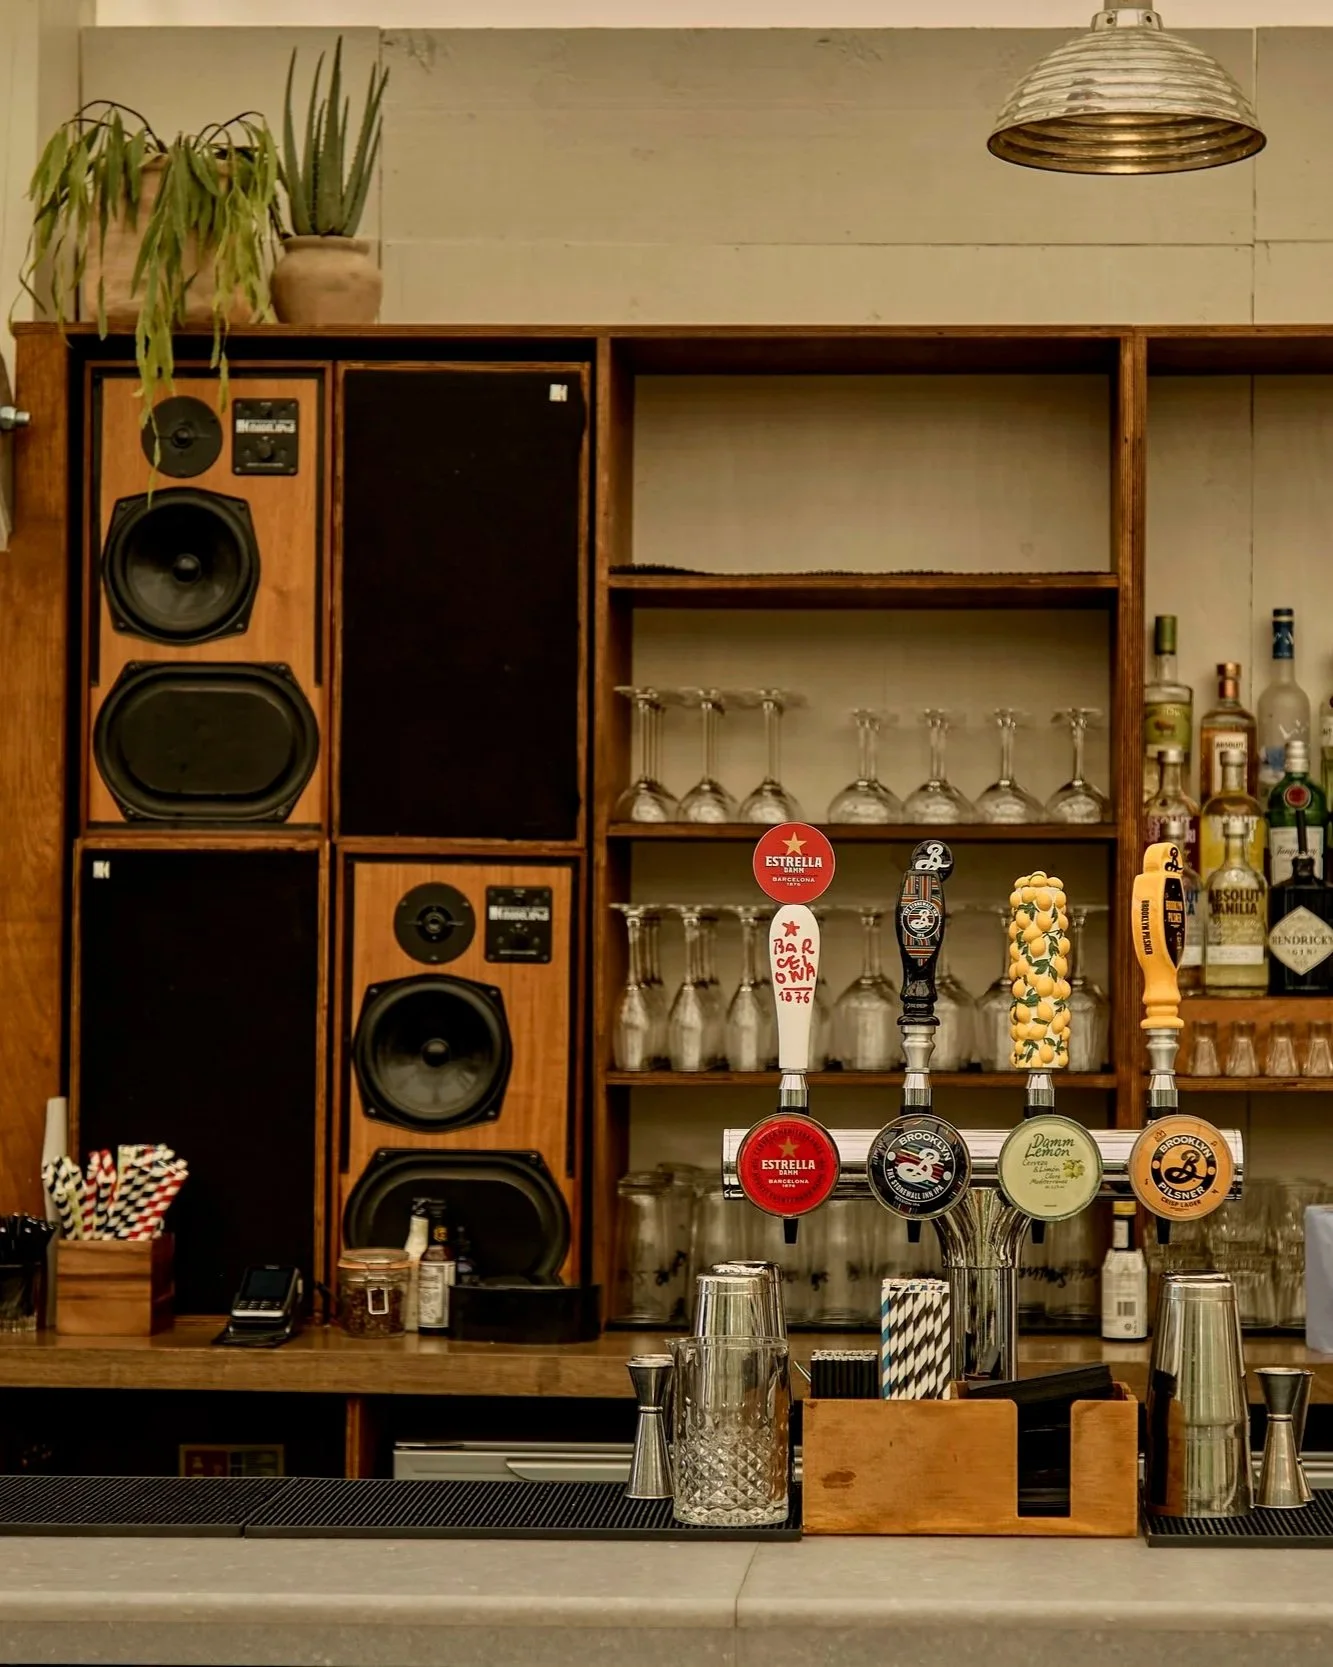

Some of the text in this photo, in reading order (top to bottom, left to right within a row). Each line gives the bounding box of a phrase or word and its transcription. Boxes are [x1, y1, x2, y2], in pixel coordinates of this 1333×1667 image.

[765, 856, 823, 868] ESTRELLA
[1208, 888, 1260, 903] ABSOLUT
[1140, 900, 1153, 955] BROOKLYN PILSNER
[773, 938, 815, 955] BAR
[778, 991, 810, 1004] 1876
[898, 1132, 952, 1161] BROOKLYN
[1032, 1133, 1076, 1148] Damm
[1159, 1136, 1212, 1158] BROOKLYN
[1025, 1143, 1070, 1158] Lemon
[761, 1160, 816, 1169] ESTRELLA
[886, 1168, 944, 1200] THE STONEWALL INN IPA
[1158, 1182, 1205, 1199] PILSNER
[1161, 1196, 1202, 1207] CRISP LAGER
